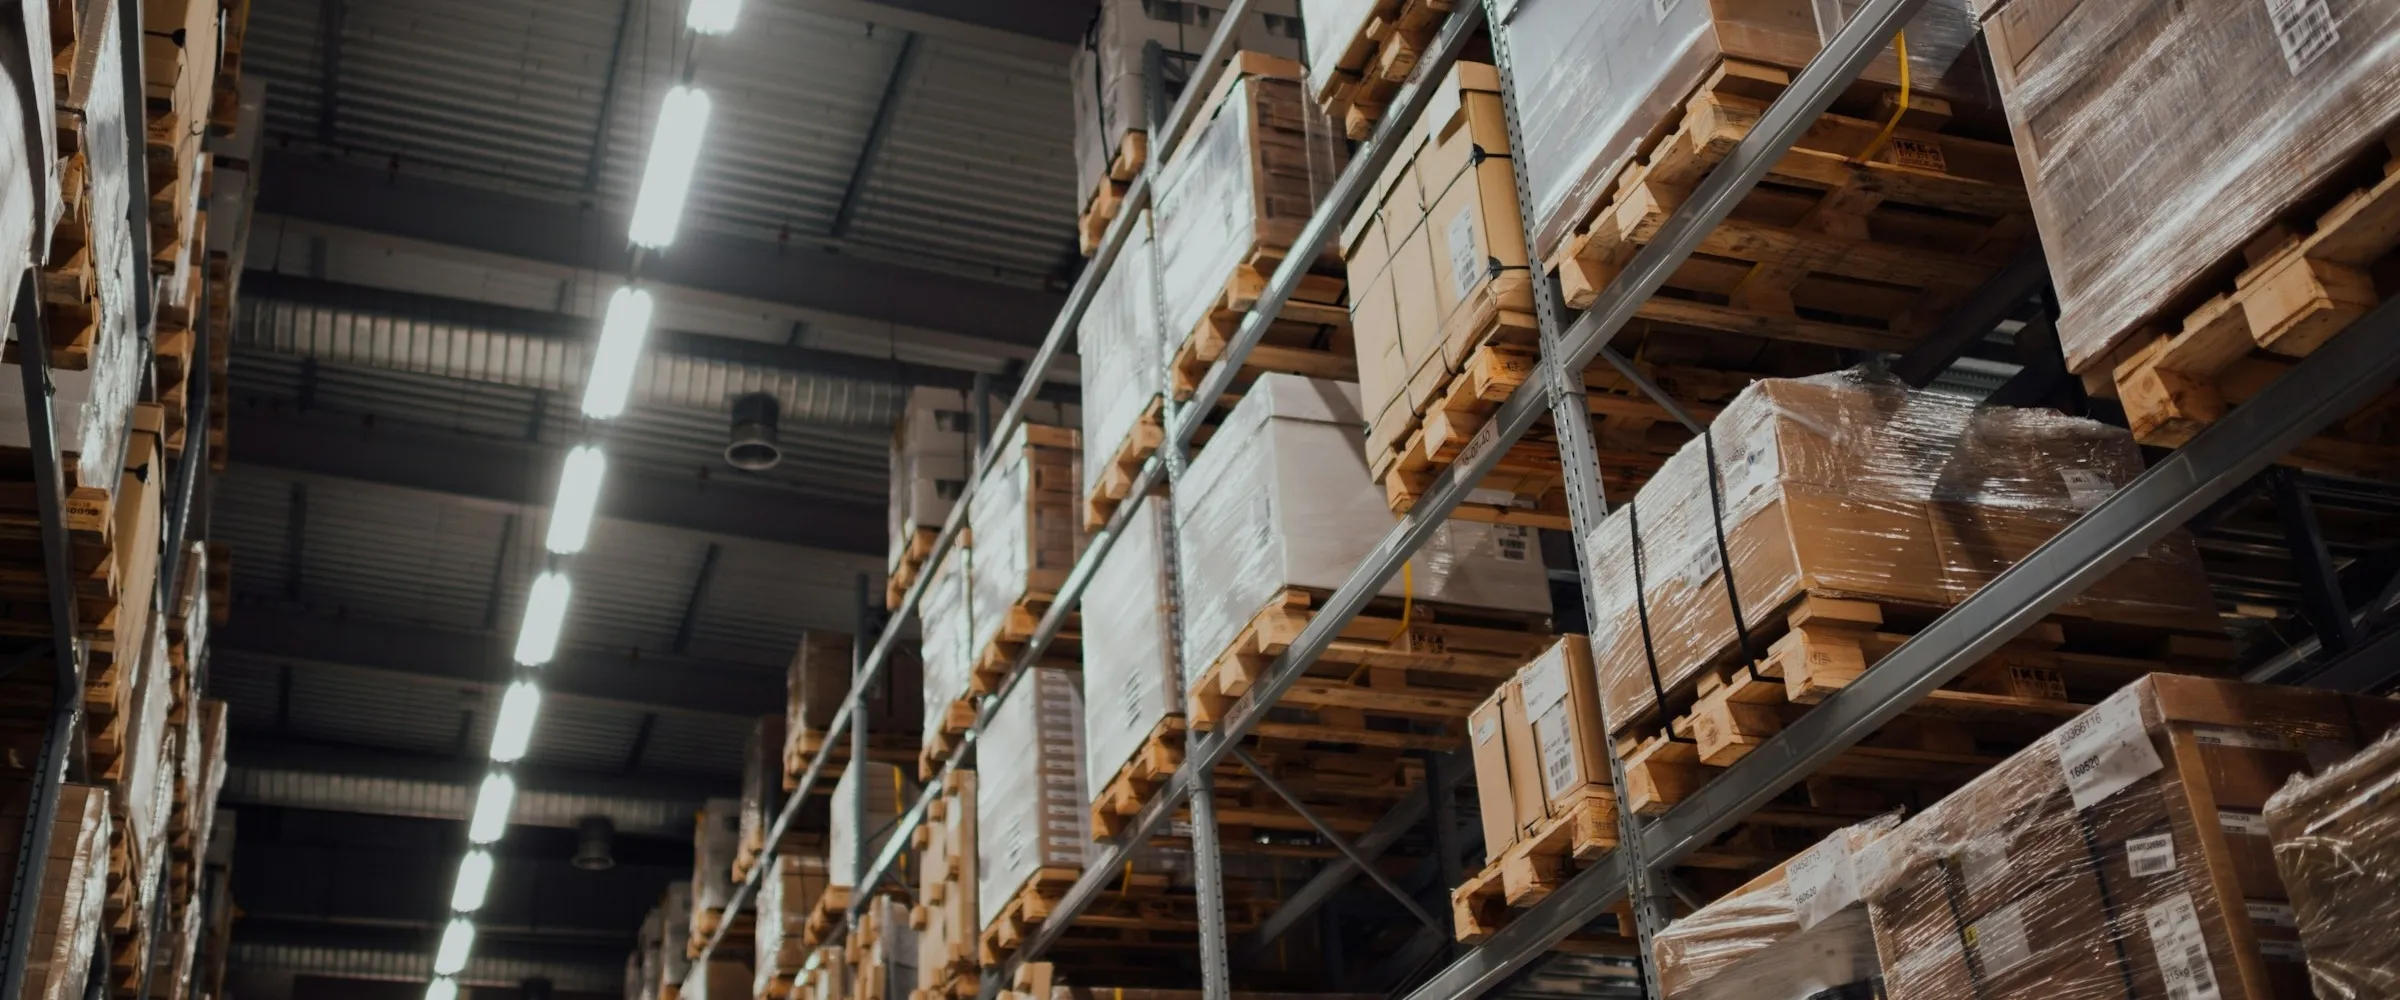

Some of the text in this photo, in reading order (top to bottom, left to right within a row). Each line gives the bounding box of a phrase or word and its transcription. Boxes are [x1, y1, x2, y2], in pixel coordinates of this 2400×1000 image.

[1896, 140, 1939, 155] IKEA
[2012, 668, 2060, 681] IKEA
[2059, 712, 2102, 746] 20366116
[2069, 755, 2100, 779] 160520
